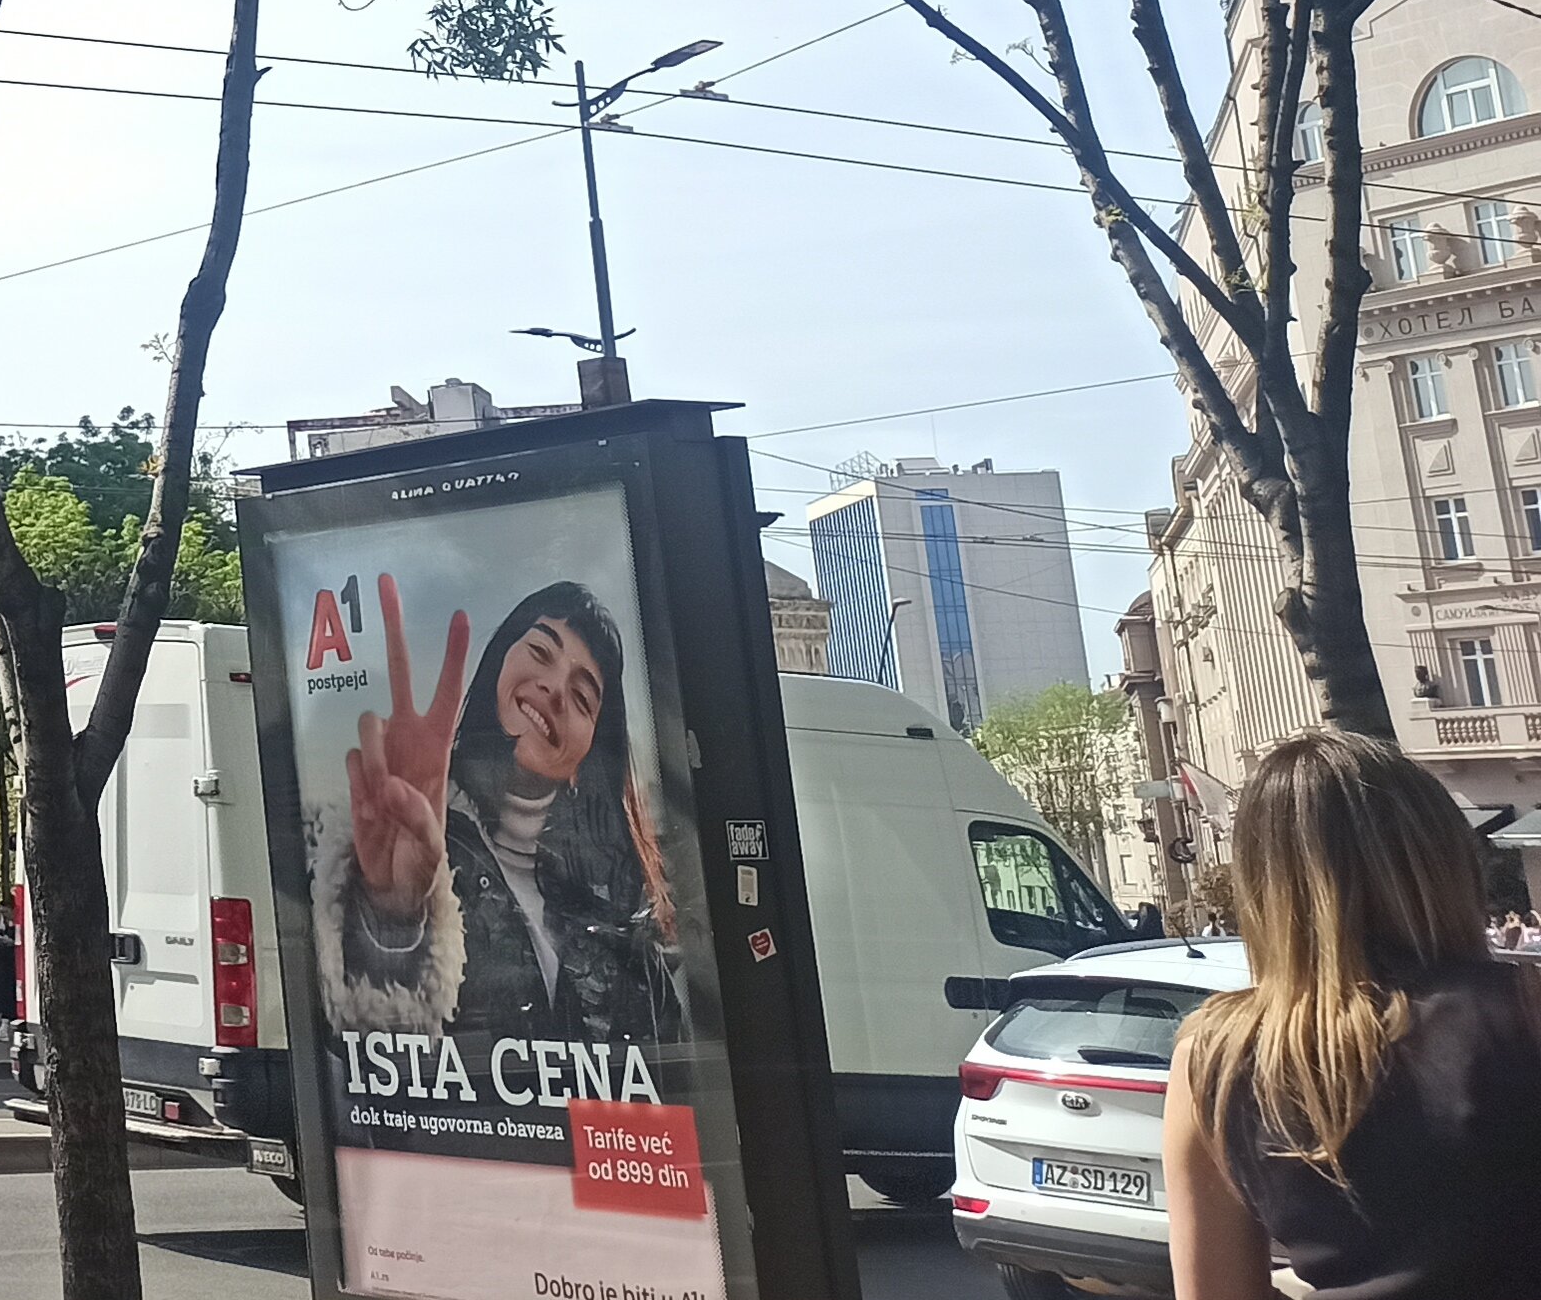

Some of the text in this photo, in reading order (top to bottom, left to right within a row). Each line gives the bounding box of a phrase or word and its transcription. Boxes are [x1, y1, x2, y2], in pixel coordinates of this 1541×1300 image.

[1378, 296, 1536, 341] ХОТЕЛ БА
[306, 574, 363, 670] A1
[307, 670, 368, 694] postpejd
[729, 823, 755, 841] fade
[731, 840, 763, 857] away
[342, 1031, 662, 1108] ISTA CENA
[350, 1105, 565, 1141] dok traje ugovorna obaveza
[583, 1125, 674, 1155] Tarife već
[252, 1150, 285, 1165] IVECO
[588, 1159, 690, 1189] od 899 din
[1044, 1163, 1068, 1187] AZ
[534, 1272, 595, 1300] Dobro
